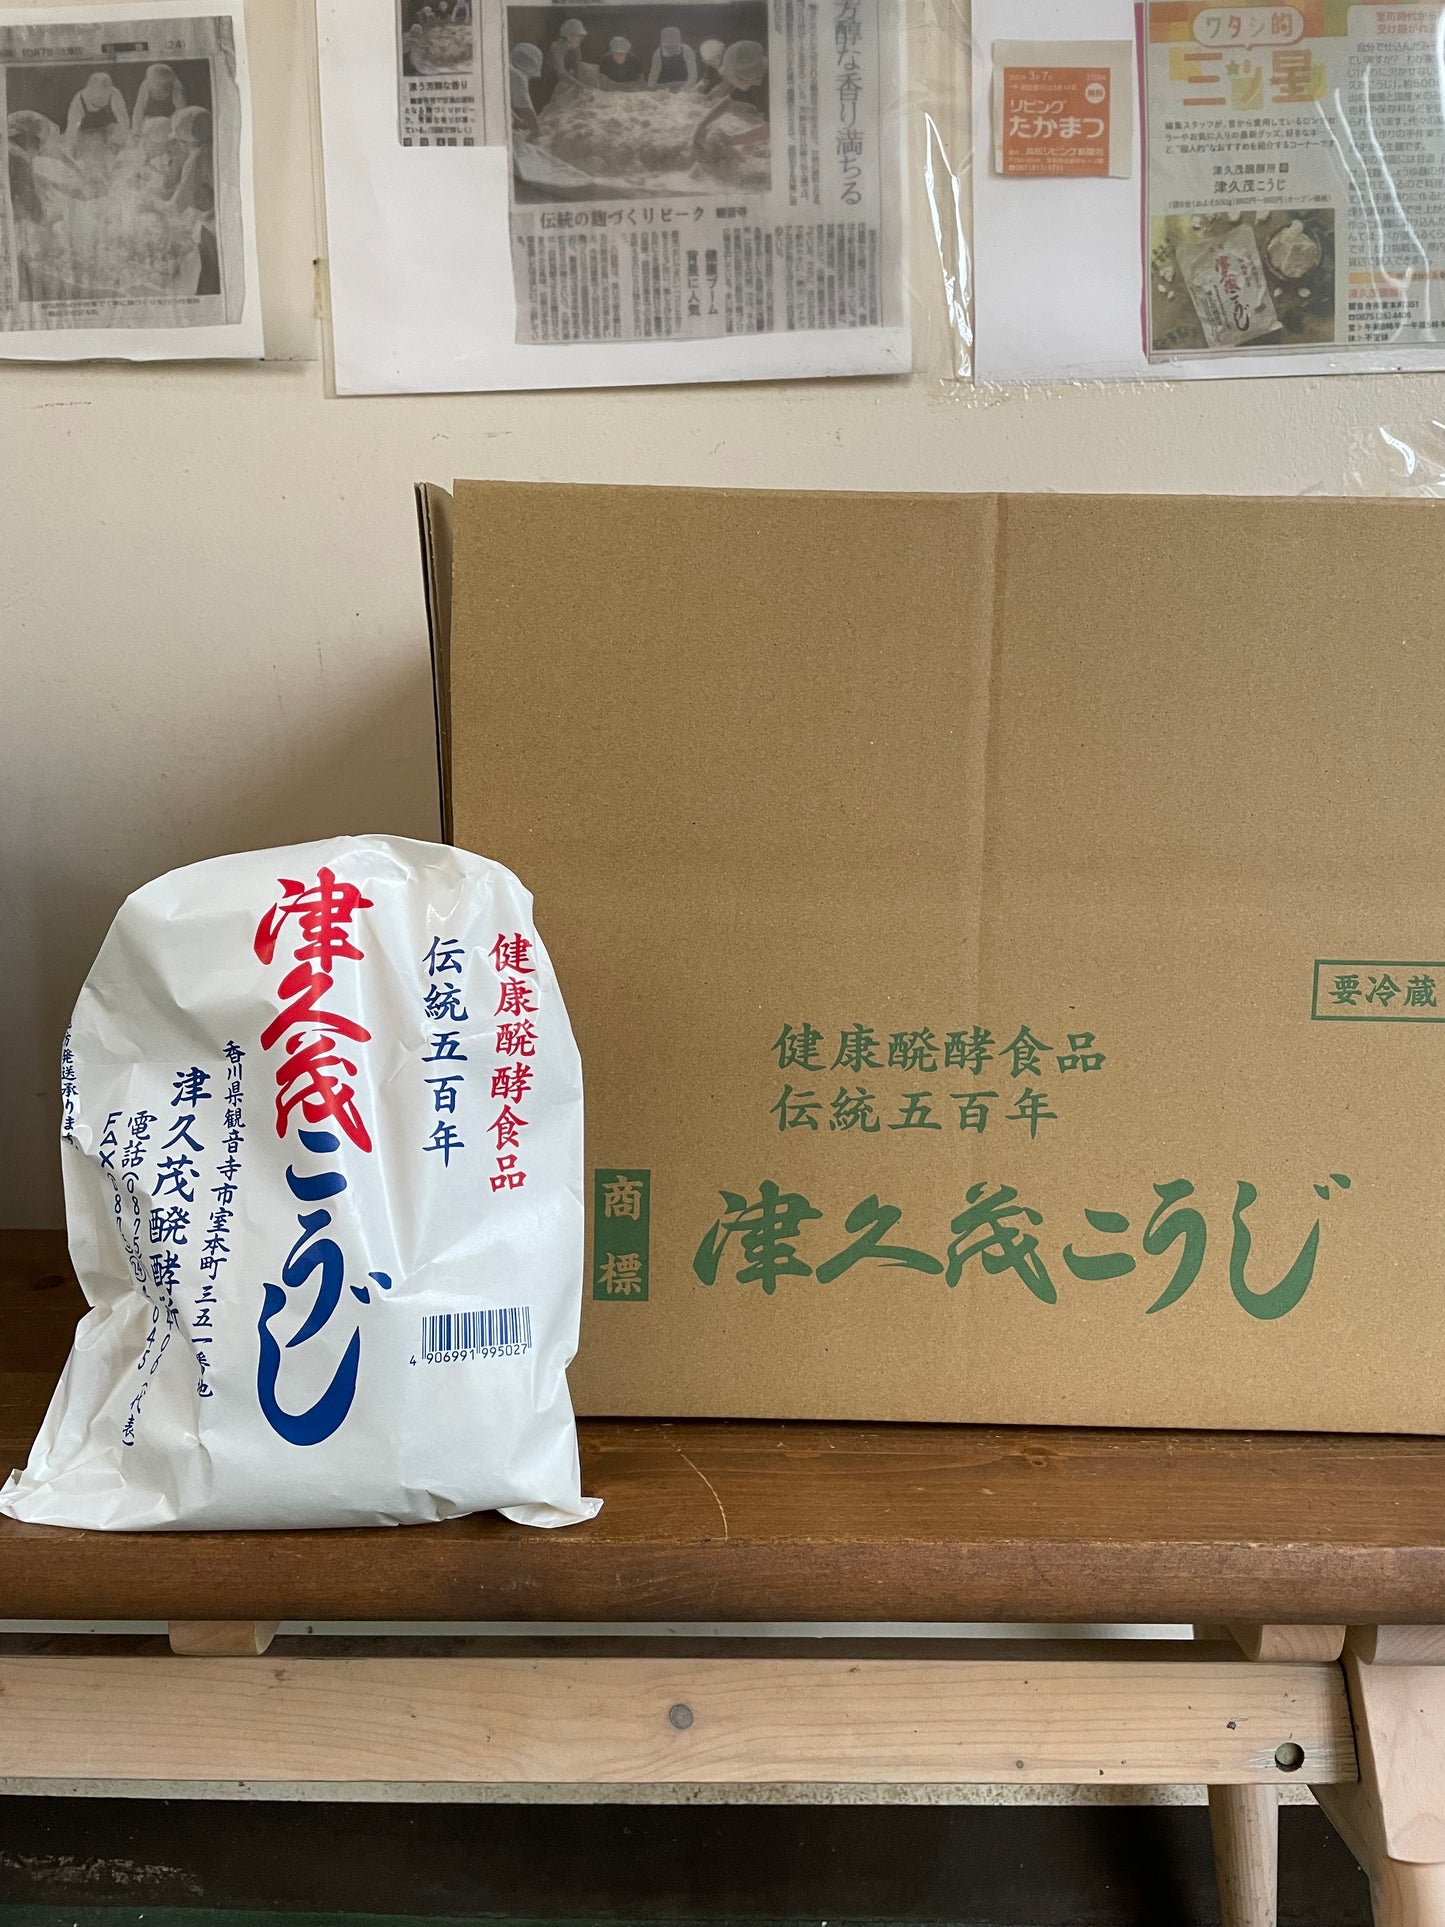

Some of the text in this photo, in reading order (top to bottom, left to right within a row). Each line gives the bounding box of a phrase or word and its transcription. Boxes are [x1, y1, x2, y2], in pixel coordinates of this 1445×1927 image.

[1205, 12, 1294, 38] ワタシ的
[1009, 115, 1105, 139] たかまつ
[1010, 99, 1067, 114] リビング
[1213, 178, 1287, 195] 津久茂こうじ
[1328, 973, 1439, 1009] 要冷蔵
[421, 935, 469, 1168] 伝統五百年
[486, 932, 540, 1193] 健康醗酵食品
[769, 1022, 1107, 1077] 健康醗酵食品
[768, 1084, 1059, 1140] 伝統五百年
[254, 866, 393, 1447] 津久茂こうじ
[598, 1173, 645, 1298] 商標
[692, 1172, 1352, 1321] 津久茂こうじ
